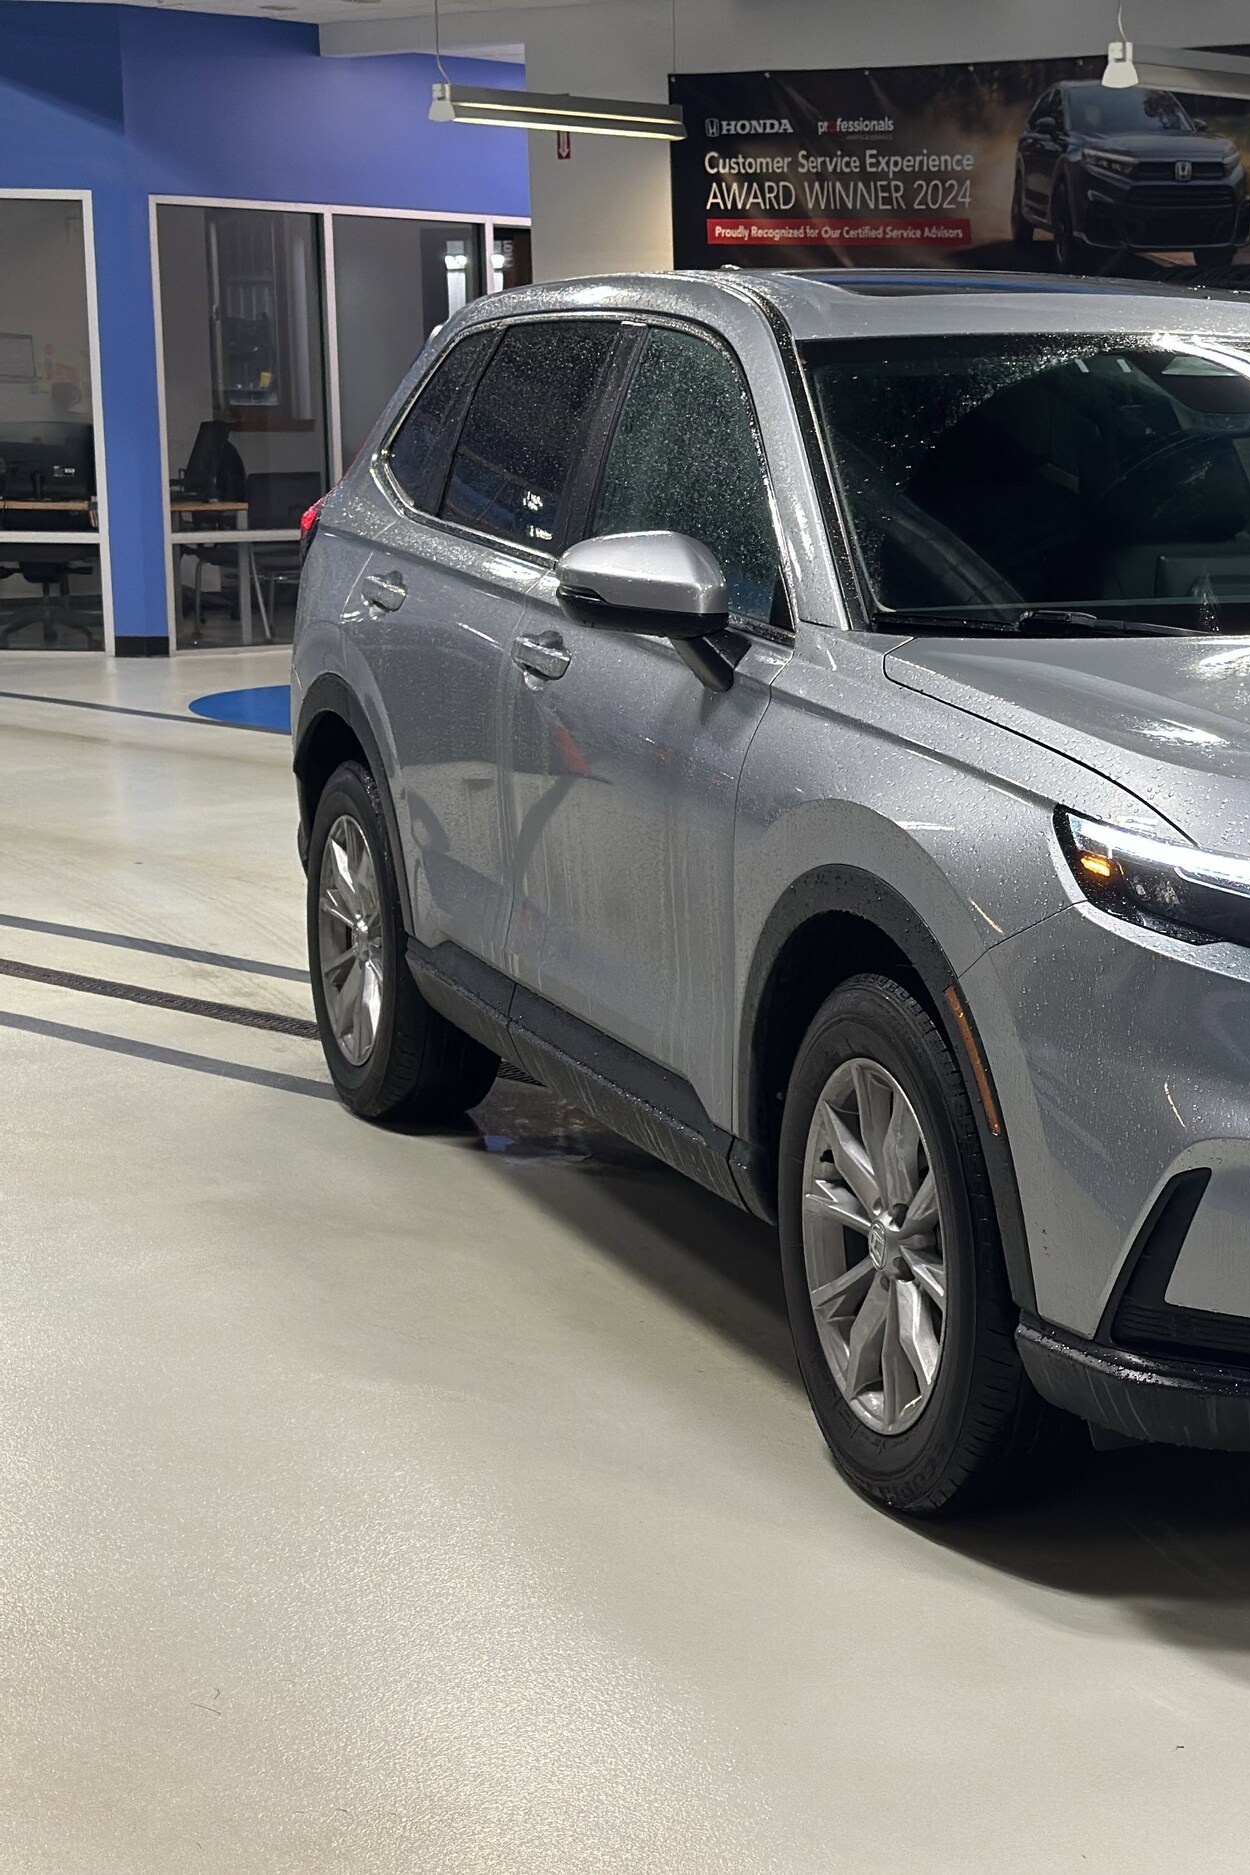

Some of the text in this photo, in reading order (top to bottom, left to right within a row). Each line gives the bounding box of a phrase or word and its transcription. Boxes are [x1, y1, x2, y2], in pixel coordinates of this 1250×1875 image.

[721, 119, 794, 135] HONDA
[817, 116, 894, 135] professionals
[704, 149, 975, 178] Customer Service Experience
[706, 179, 972, 210] AWARD WINNER 2024
[714, 224, 963, 241] Proudly Recognized for Our Certified Service Advisors
